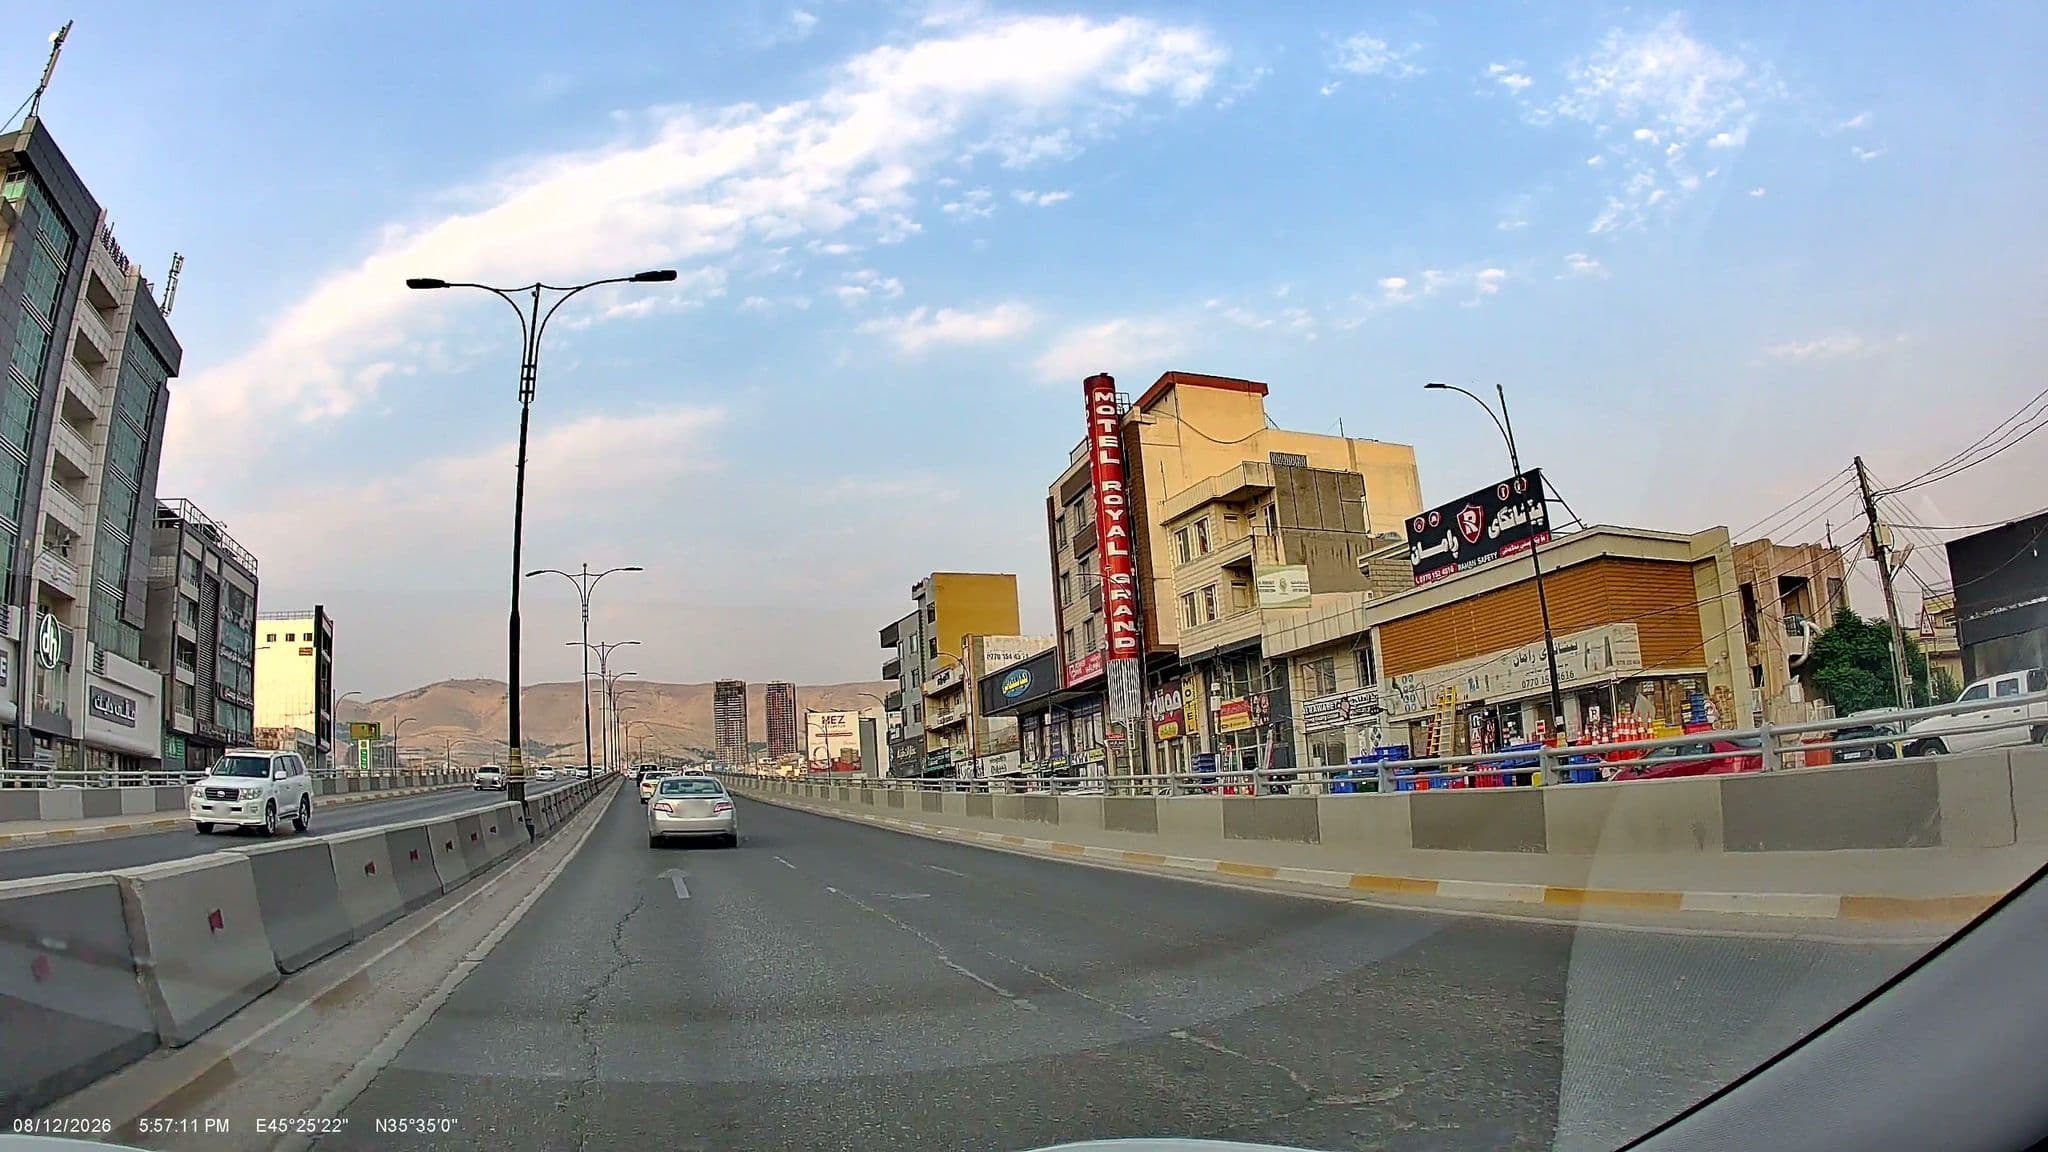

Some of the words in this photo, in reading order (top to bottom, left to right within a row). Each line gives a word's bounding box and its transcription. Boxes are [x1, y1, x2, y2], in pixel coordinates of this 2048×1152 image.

[1095, 391, 1121, 466] MOTEL
[1102, 480, 1129, 558] ROYAL
[1477, 551, 1498, 565] SAFETY
[1110, 572, 1137, 650] GRAND
[1183, 677, 1195, 732] MOTEL
[1521, 677, 1539, 689] 0770
